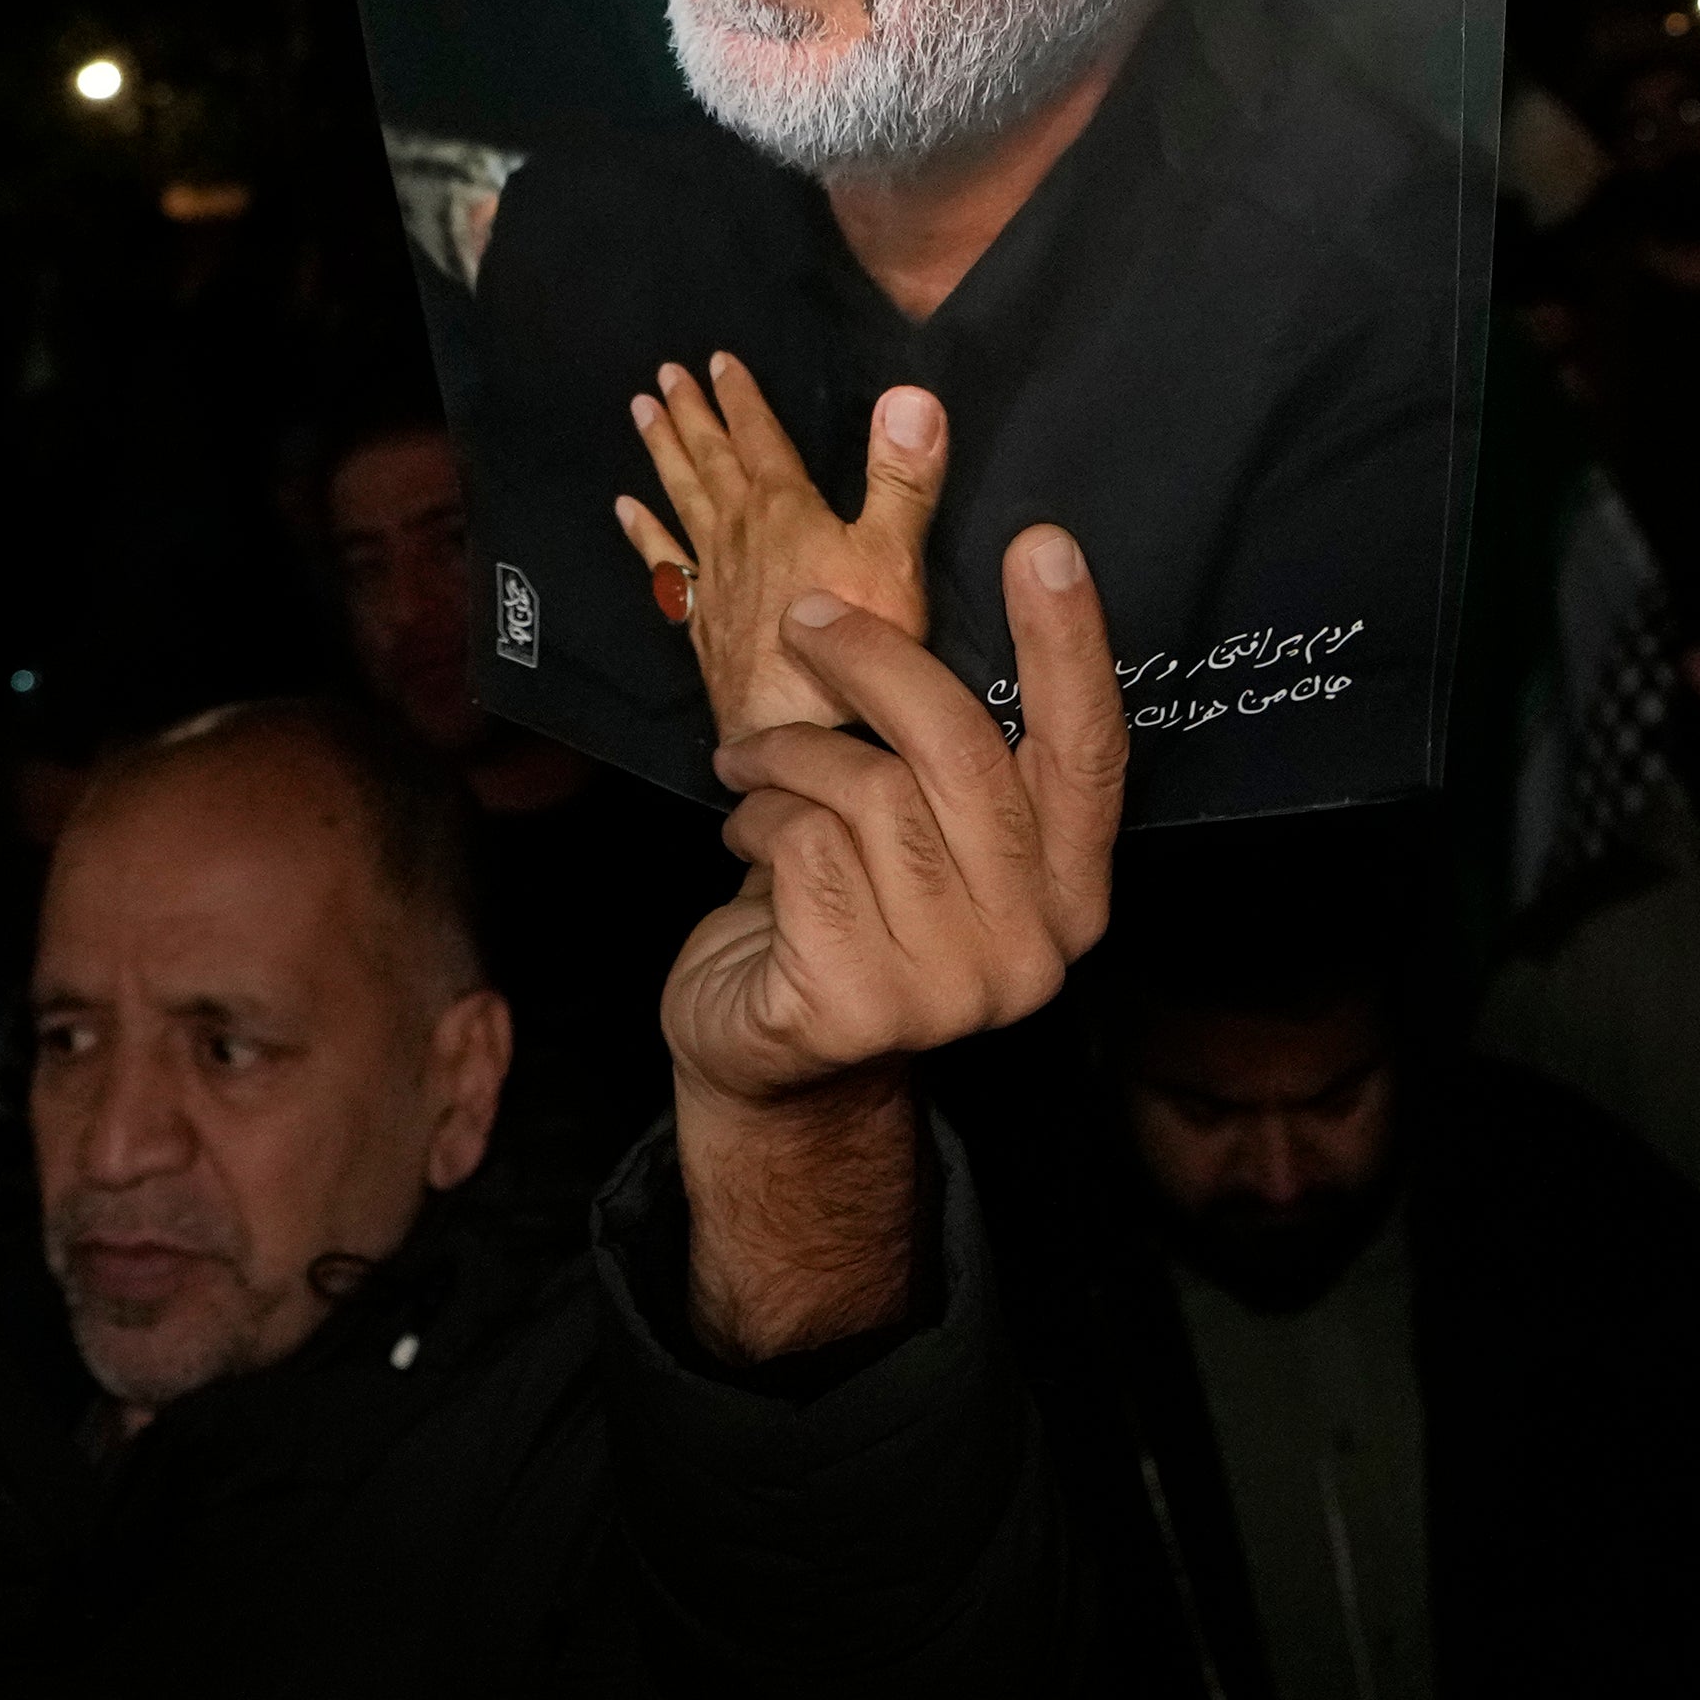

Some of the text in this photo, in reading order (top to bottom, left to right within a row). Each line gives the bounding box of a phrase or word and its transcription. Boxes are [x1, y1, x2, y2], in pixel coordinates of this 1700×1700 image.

[1304, 618, 1365, 666] مردم
[1155, 658, 1179, 681] و
[1237, 688, 1289, 715] من
[1289, 674, 1353, 702] جان
[1133, 699, 1229, 733] هزاران
